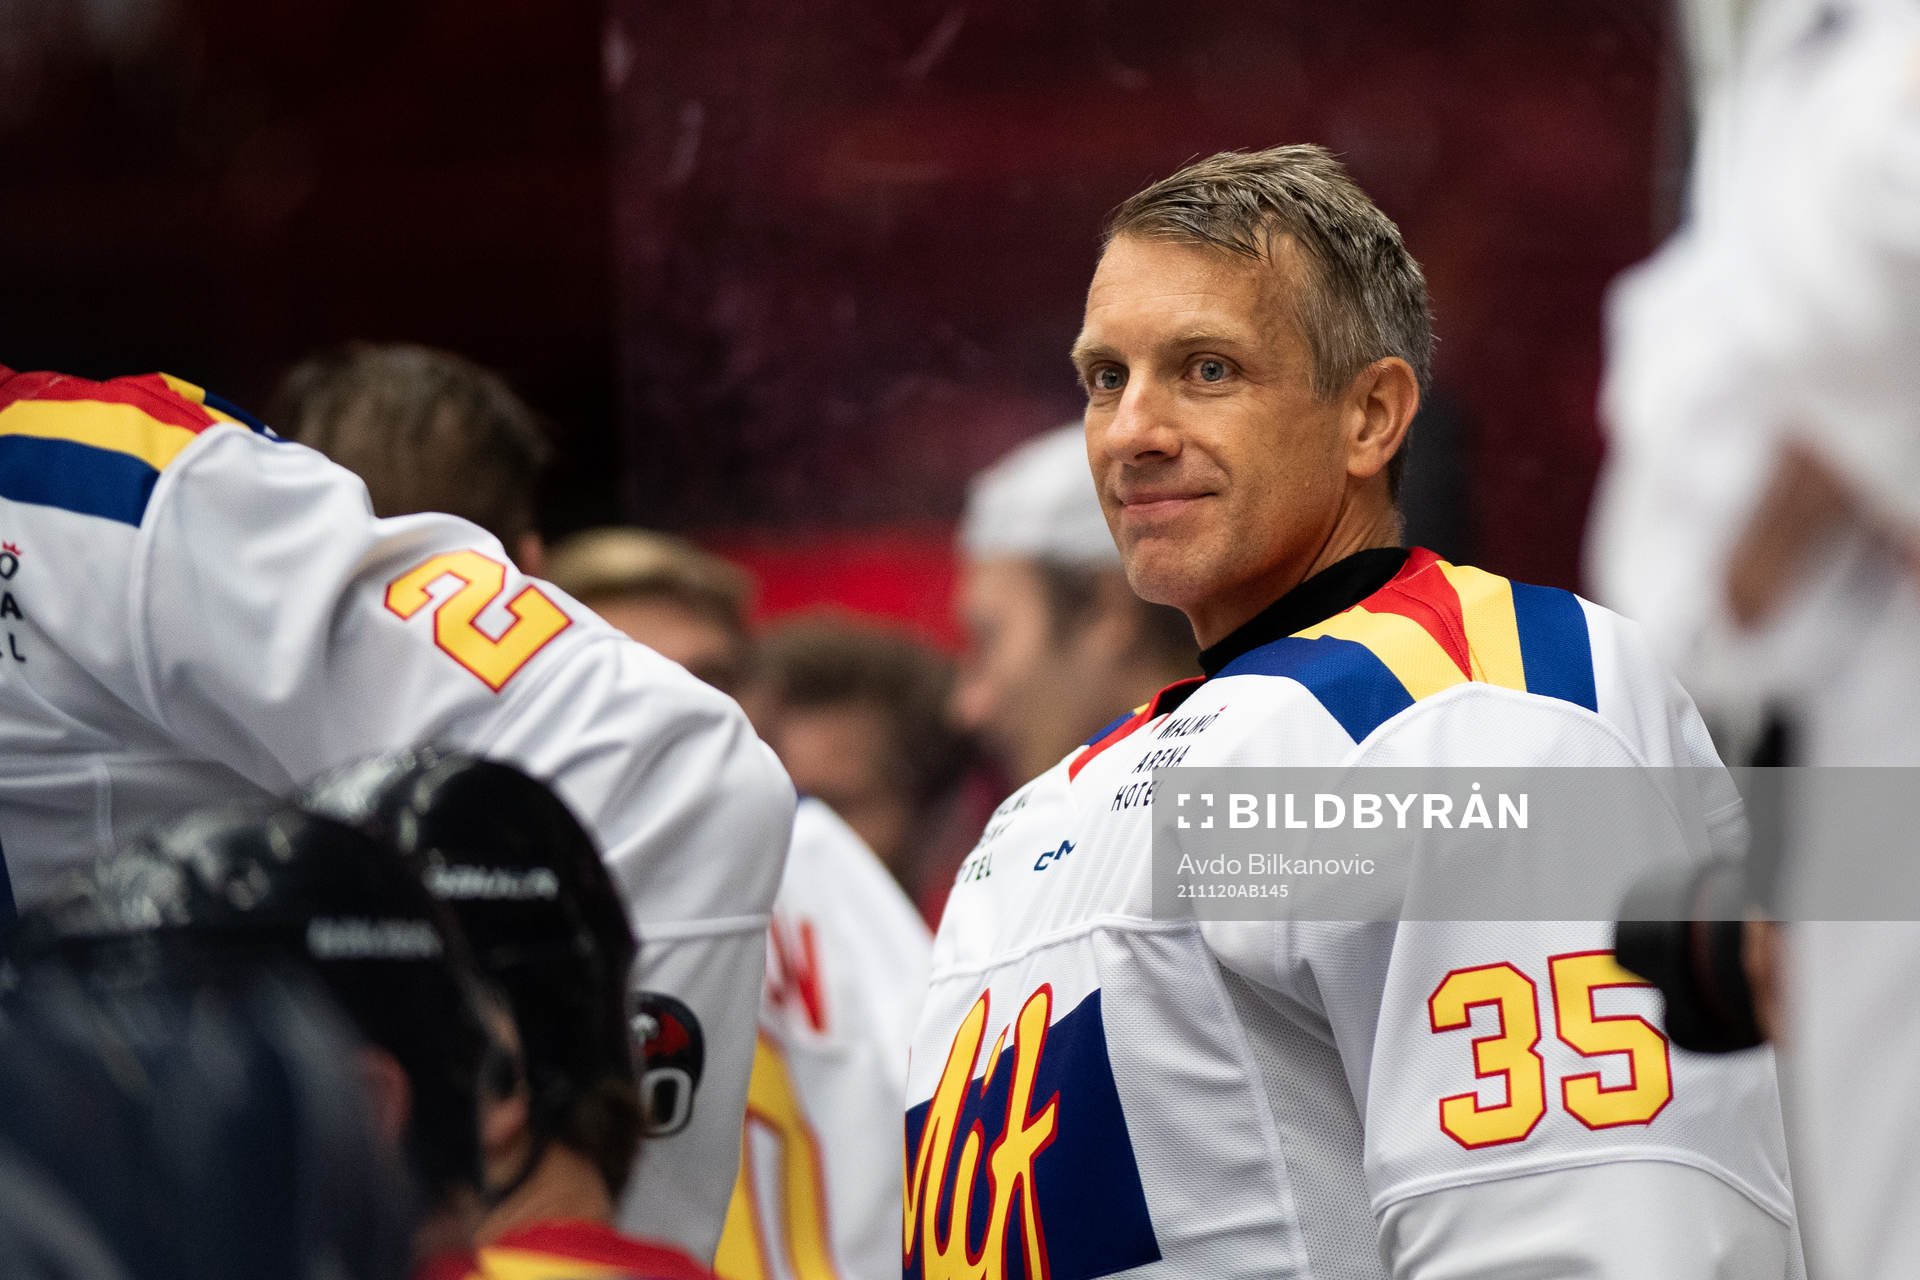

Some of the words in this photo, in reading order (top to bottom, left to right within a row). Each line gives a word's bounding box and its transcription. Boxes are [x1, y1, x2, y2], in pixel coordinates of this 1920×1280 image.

[384, 549, 574, 693] 2
[1131, 744, 1191, 774] ARENA
[1428, 948, 1675, 1151] 35
